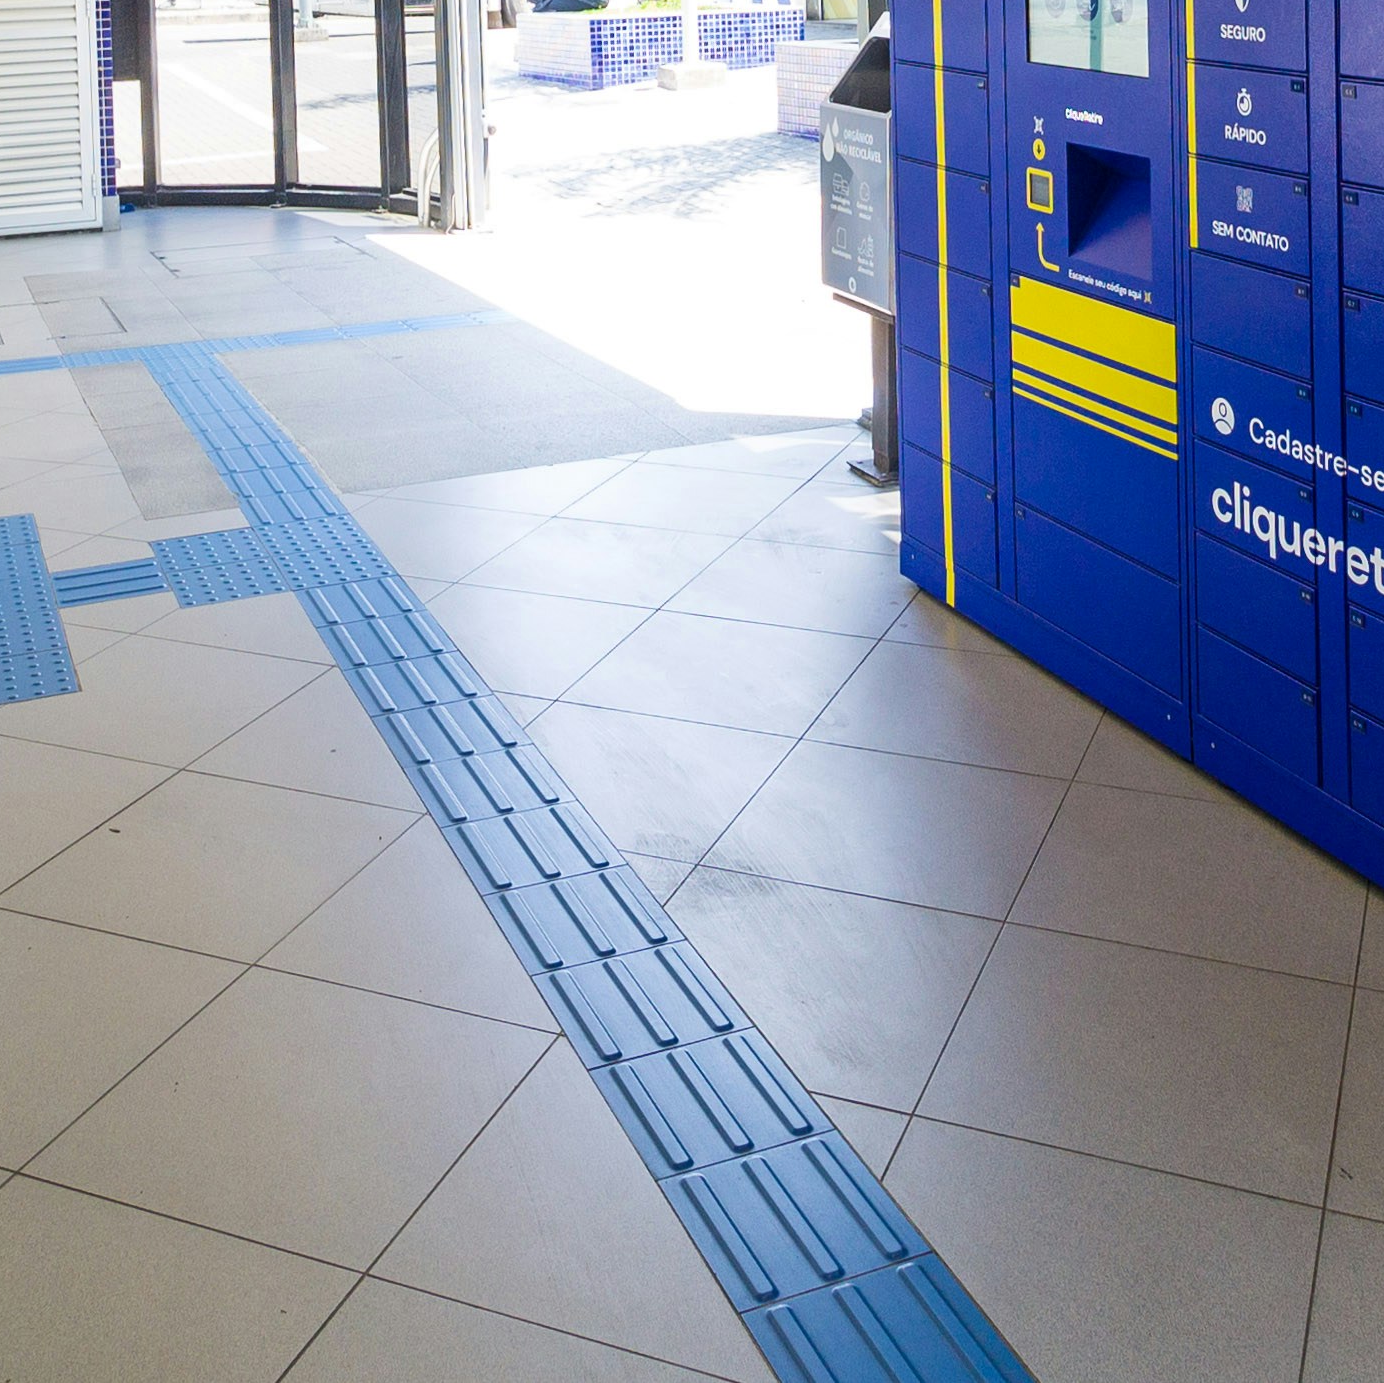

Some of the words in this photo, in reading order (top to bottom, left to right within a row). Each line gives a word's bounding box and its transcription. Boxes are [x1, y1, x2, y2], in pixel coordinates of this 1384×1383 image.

[1220, 23, 1266, 43] SEGURO
[1224, 123, 1267, 146] RÁPIDO
[1212, 220, 1233, 239] SEM
[1235, 225, 1289, 252] CONTATO
